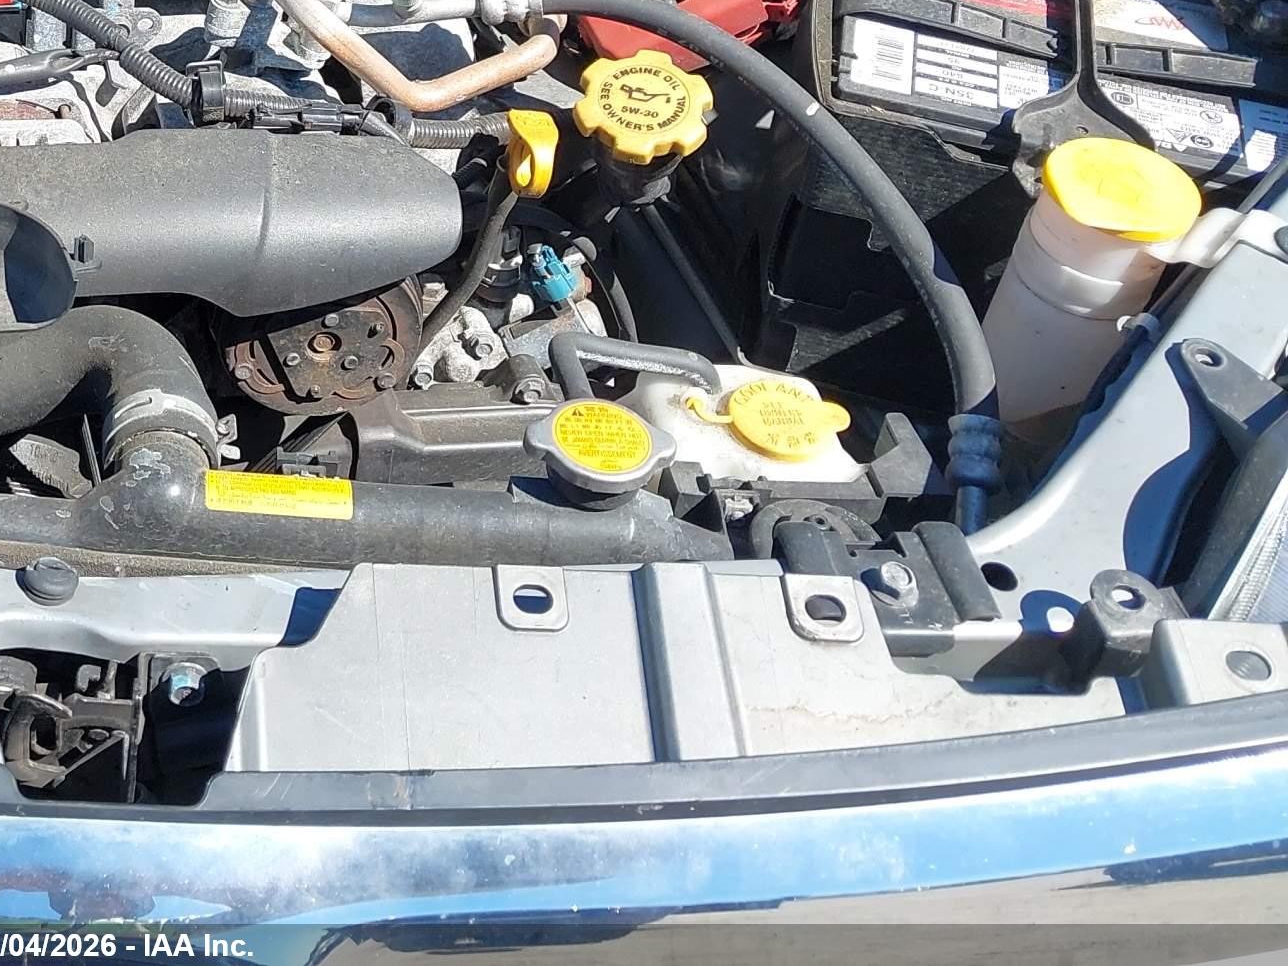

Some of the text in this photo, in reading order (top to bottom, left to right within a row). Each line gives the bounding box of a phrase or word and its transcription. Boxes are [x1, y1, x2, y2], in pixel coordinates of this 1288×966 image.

[612, 67, 680, 91] ENGINE OIL
[600, 81, 686, 131] SEE OWNER'S MANUAL
[620, 105, 659, 119] 5W-30
